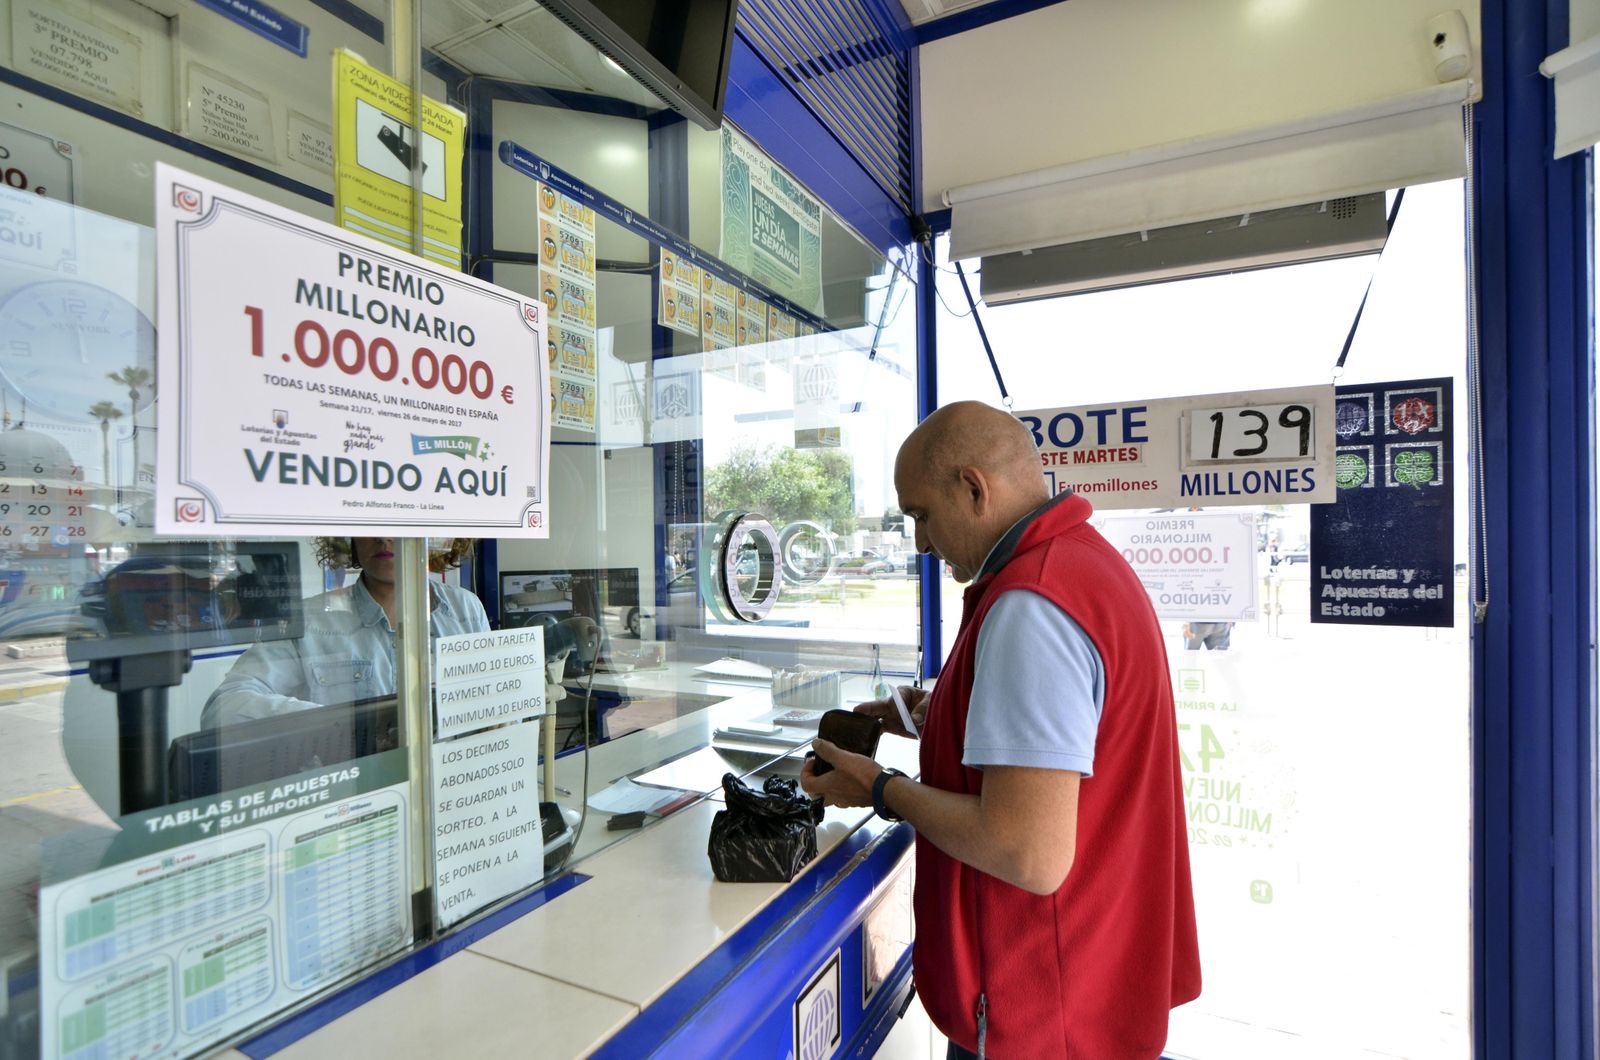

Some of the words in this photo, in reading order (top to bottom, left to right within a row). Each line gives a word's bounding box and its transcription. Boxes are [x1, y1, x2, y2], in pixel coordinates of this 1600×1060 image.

[50, 30, 109, 62] PREMIO
[72, 29, 120, 55] NAVIDAD
[30, 46, 80, 73] VENDIDO
[216, 93, 246, 111] 45230
[349, 65, 380, 90] ZONA
[381, 82, 454, 128] VIDEOGILADA
[202, 115, 238, 135] VENDIDO
[214, 102, 248, 123] Premio
[732, 136, 746, 156] Play
[746, 149, 759, 165] one
[750, 171, 762, 187] and
[763, 180, 774, 194] two
[753, 191, 775, 219] JUEGAS
[559, 230, 584, 246] 57091
[753, 206, 769, 234] UN
[769, 221, 786, 243] DÍA
[753, 227, 760, 241] 2
[761, 233, 799, 270] SEMANAS
[338, 252, 444, 305] PREMIO
[560, 280, 585, 296] 57091
[295, 278, 475, 347] MILLONARIO
[560, 331, 585, 345] 57091
[244, 305, 494, 400] 1.000.000
[501, 385, 514, 404] €
[264, 374, 303, 390] TODAS
[306, 381, 327, 394] LAS
[328, 385, 381, 403] SEMANAS,
[383, 395, 399, 405] UN
[400, 397, 454, 415] MILLONARIO
[455, 408, 467, 417] EN
[468, 409, 499, 421] ESPAÑA
[560, 381, 585, 394] 57091
[320, 400, 349, 411] Semana
[377, 410, 401, 419] viernes
[402, 412, 410, 420] 26
[421, 415, 439, 425] mayo
[260, 435, 273, 443] del
[274, 437, 301, 447] Estado
[282, 430, 318, 440] Apuestas
[1210, 404, 1311, 459] 139
[418, 441, 432, 450] EL
[1041, 451, 1069, 466] STE
[1073, 447, 1139, 464] MARTES
[33, 462, 44, 474] 6
[243, 448, 422, 491] VENDIDO
[434, 465, 508, 497] AQUÍ
[31, 484, 48, 495] 13
[67, 486, 83, 497] 14
[1180, 467, 1317, 497] MILLONES
[27, 504, 51, 516] 20
[67, 505, 83, 517] 21
[342, 500, 364, 508] Pedro
[366, 501, 391, 509] Alfonso
[393, 502, 415, 510] Franco
[29, 526, 50, 537] 27
[67, 526, 87, 537] 28
[1320, 564, 1398, 580] Loterías
[1401, 566, 1415, 583] y
[1321, 583, 1410, 600] Apuestas
[1412, 583, 1444, 600] del
[1321, 602, 1386, 617] Estado
[440, 639, 471, 654] PAGO
[472, 636, 496, 651] CON
[497, 631, 537, 649] TARJETA
[443, 662, 488, 680] MINIMO
[489, 658, 503, 671] 10
[503, 653, 538, 669] EUROS.
[440, 683, 492, 705] PAYMENT
[495, 678, 522, 694] CARD
[441, 705, 496, 729] MINIMUM
[497, 703, 511, 716] 10
[511, 697, 542, 712] EUROS
[441, 750, 464, 765] LOS
[465, 738, 511, 761] DECIMOS
[440, 764, 500, 790] ABONADOS
[501, 756, 525, 774] SOLO
[146, 800, 235, 833] TABLAS
[239, 789, 267, 808] DE
[271, 766, 361, 801] APUESTAS
[438, 801, 453, 814] SE
[454, 787, 508, 810] GUARDAN
[511, 779, 526, 793] UN
[200, 820, 218, 834] Y
[219, 812, 248, 828] SU
[252, 788, 330, 820] IMPORTE
[436, 815, 487, 837] SORTEO.
[491, 811, 500, 822] A
[505, 804, 519, 818] LA
[436, 837, 487, 862] SEMANA
[488, 819, 538, 846] SIGUIENTE
[438, 873, 451, 887] SE
[452, 859, 492, 880] PONEN
[493, 855, 503, 867] A
[506, 848, 520, 862] LA
[440, 886, 478, 911] VENTA.
